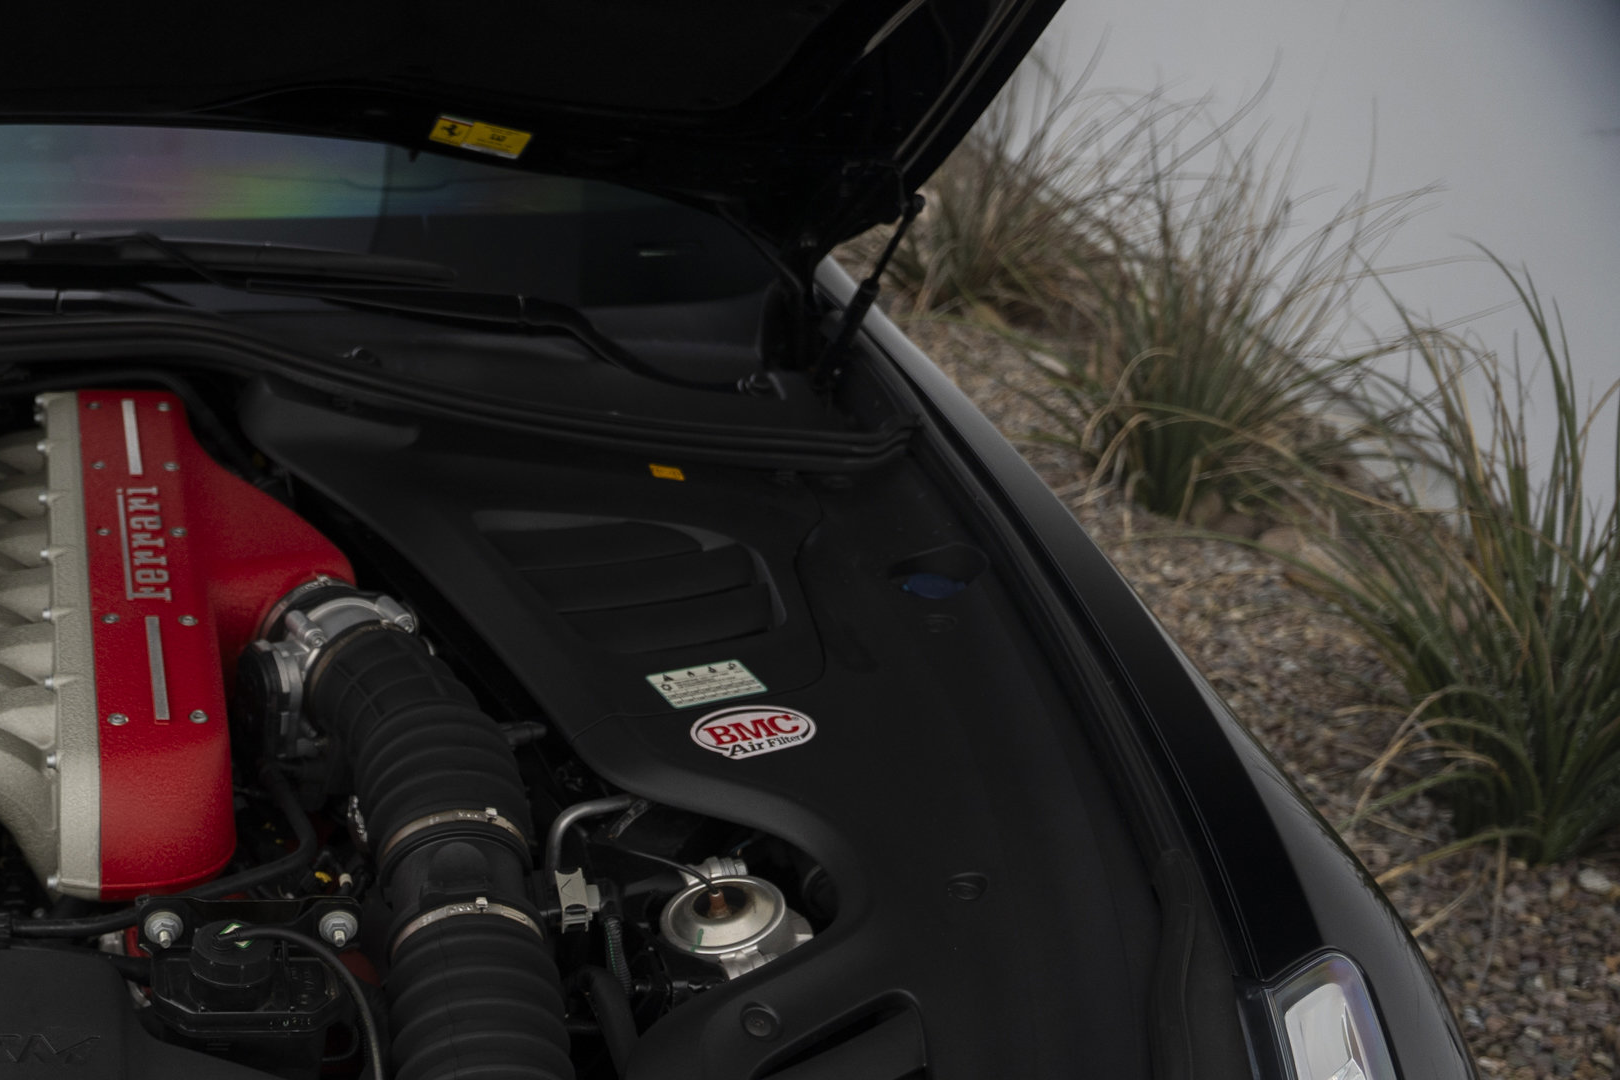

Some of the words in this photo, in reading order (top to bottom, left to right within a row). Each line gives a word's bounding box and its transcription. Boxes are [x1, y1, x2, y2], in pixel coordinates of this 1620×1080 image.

[116, 485, 172, 602] Ferrari
[703, 715, 800, 747] BMC
[728, 741, 766, 758] Air
[767, 734, 803, 751] Filter
